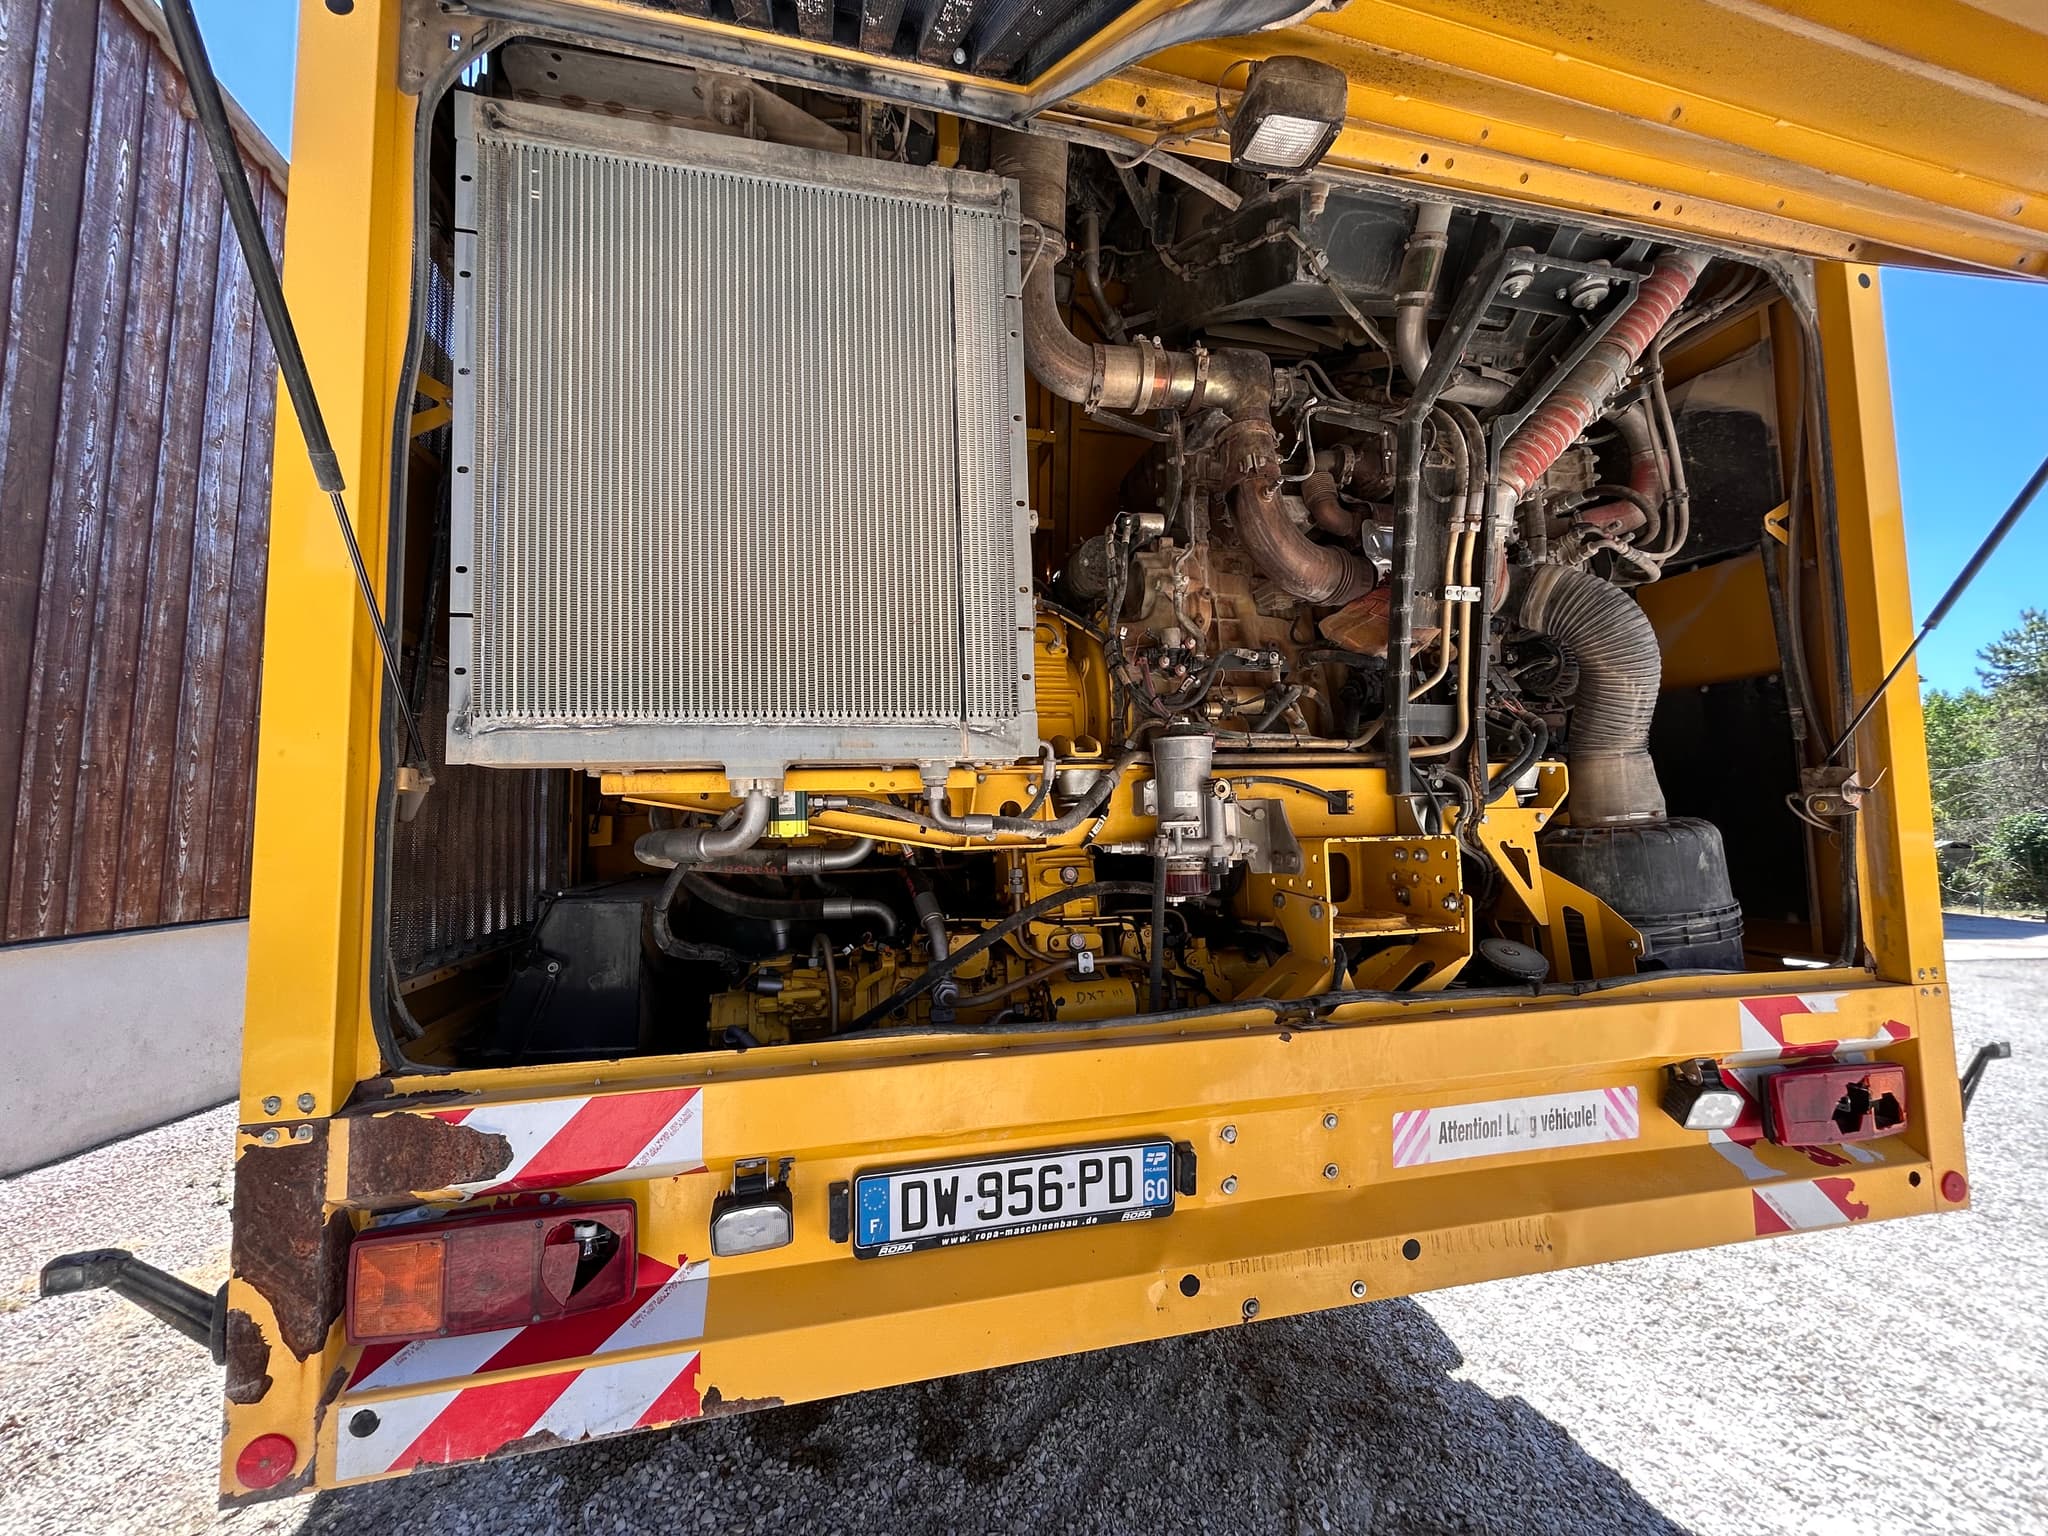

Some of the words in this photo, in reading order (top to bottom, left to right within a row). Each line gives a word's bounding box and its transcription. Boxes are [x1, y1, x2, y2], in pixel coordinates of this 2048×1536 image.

[1438, 1113, 1502, 1144] Attention!
[1541, 1103, 1597, 1132] véhicule!
[901, 1155, 1133, 1232] DW-956-PD
[1144, 1178, 1168, 1201] 60
[1122, 1210, 1152, 1221] ROPA
[870, 1218, 880, 1234] F
[879, 1243, 914, 1255] ROPA
